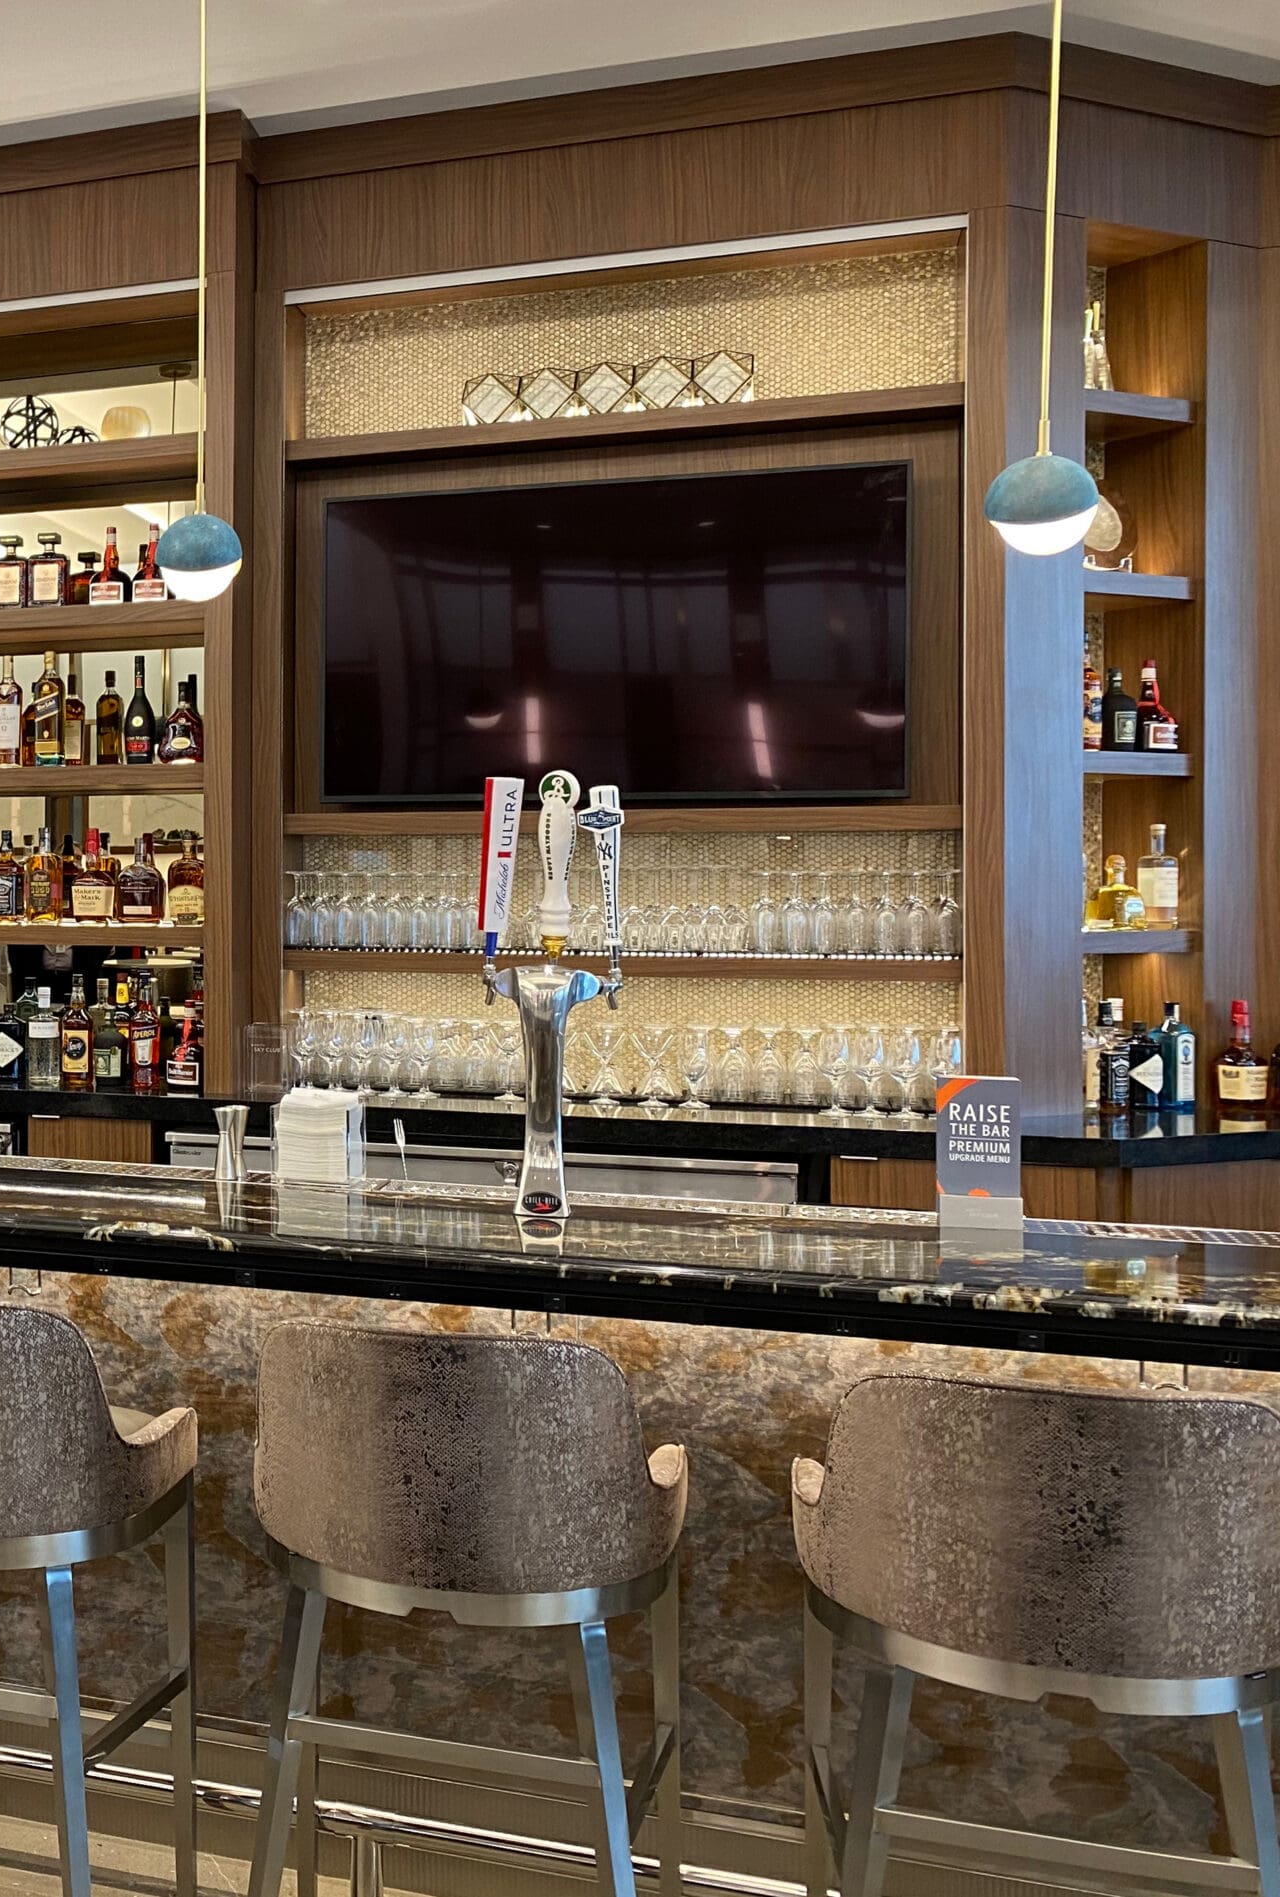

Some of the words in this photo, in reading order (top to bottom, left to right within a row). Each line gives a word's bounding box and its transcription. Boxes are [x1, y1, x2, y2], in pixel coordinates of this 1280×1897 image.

[501, 789, 518, 847] ULTRA
[493, 862, 510, 920] Michelob
[602, 864, 614, 929] PINSTRIPE
[949, 1103, 1010, 1123] RAISE
[950, 1123, 976, 1136] THE
[982, 1124, 1010, 1138] BAR
[949, 1140, 1010, 1154] PREMIUM
[949, 1154, 985, 1162] UPGRADE
[987, 1155, 1010, 1163] MENU
